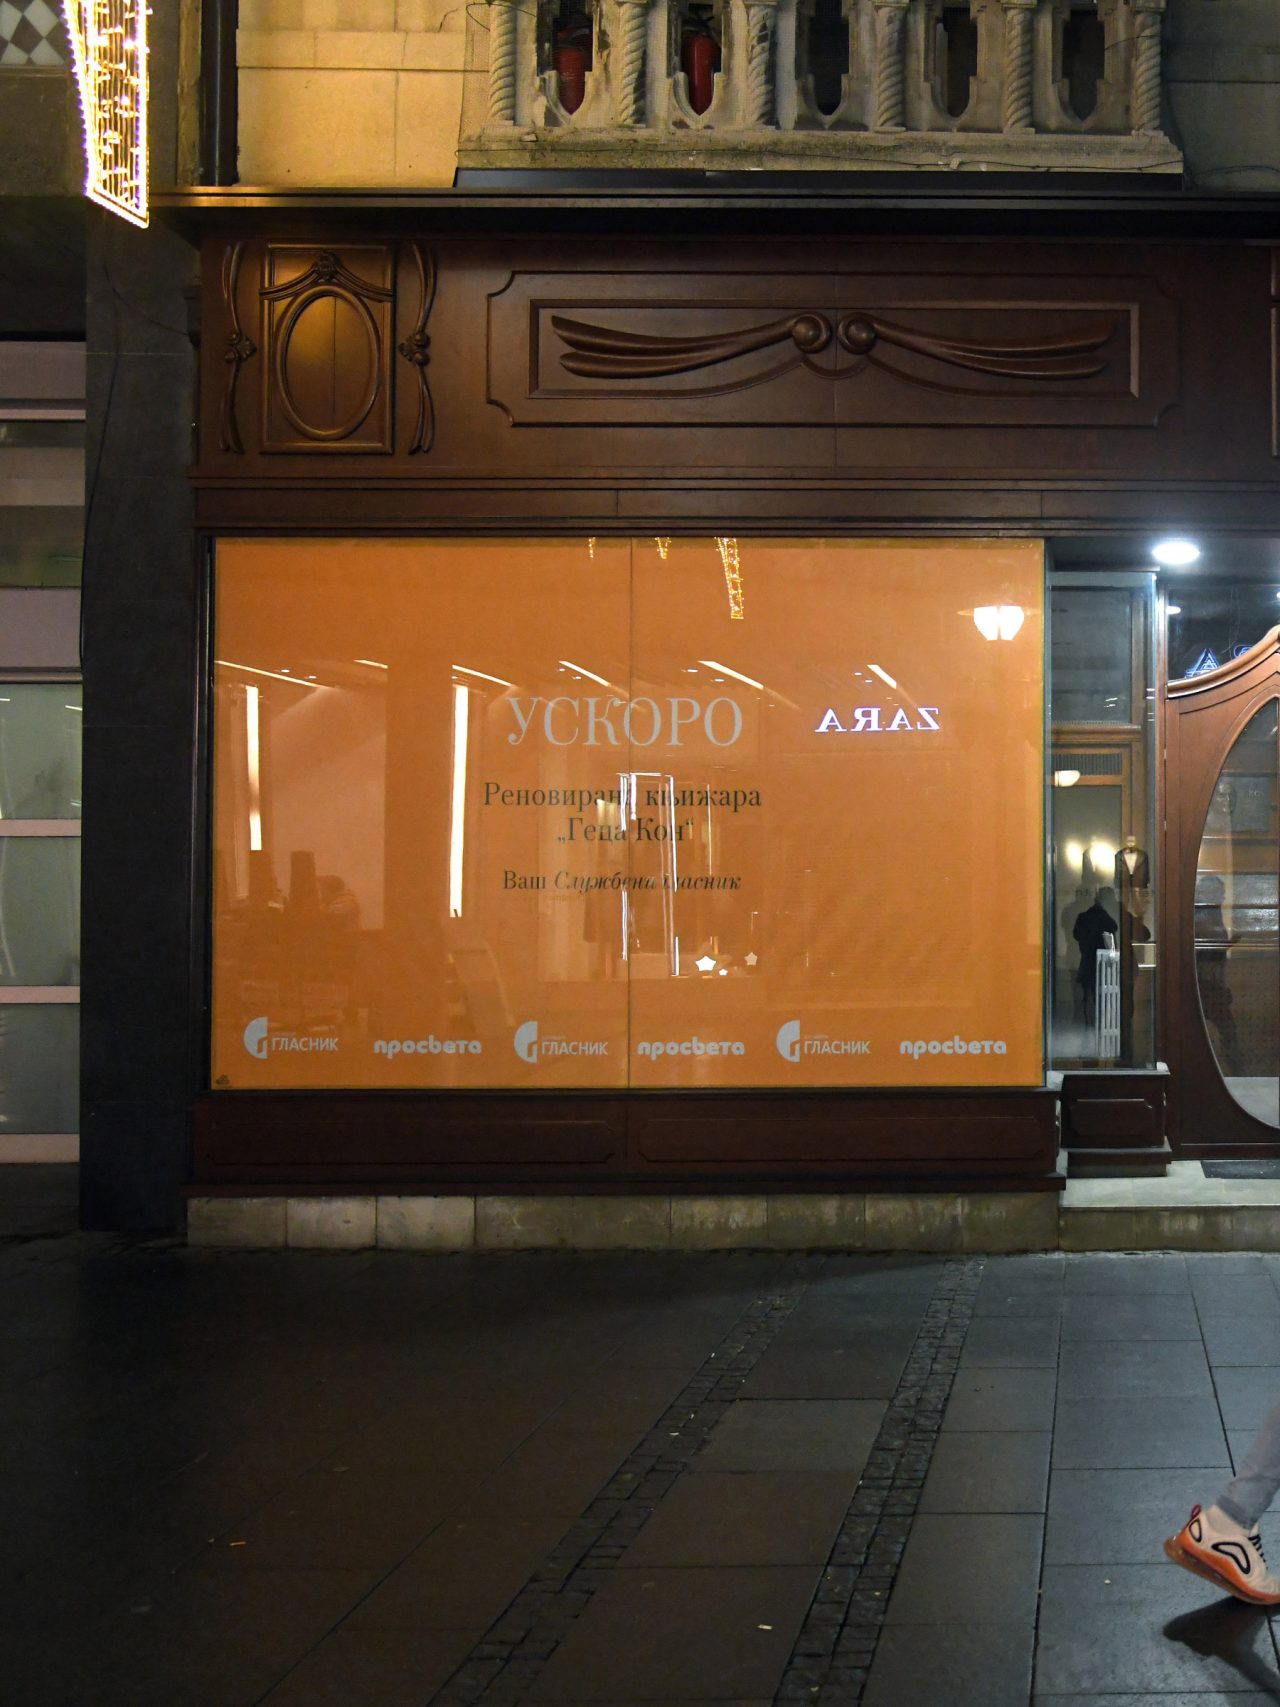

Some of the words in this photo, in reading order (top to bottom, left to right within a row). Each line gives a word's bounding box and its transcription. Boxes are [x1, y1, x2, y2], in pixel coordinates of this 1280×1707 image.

[507, 696, 743, 746] УСКОРО
[503, 870, 546, 890] Ваш
[271, 1037, 339, 1051] ГЛАСНИК
[373, 1034, 483, 1059] просвета
[541, 1041, 609, 1056] ГЛАСНИК
[637, 1036, 746, 1061] просвета
[803, 1040, 871, 1055] ГЛАСНИК
[899, 1035, 1007, 1060] просвета
